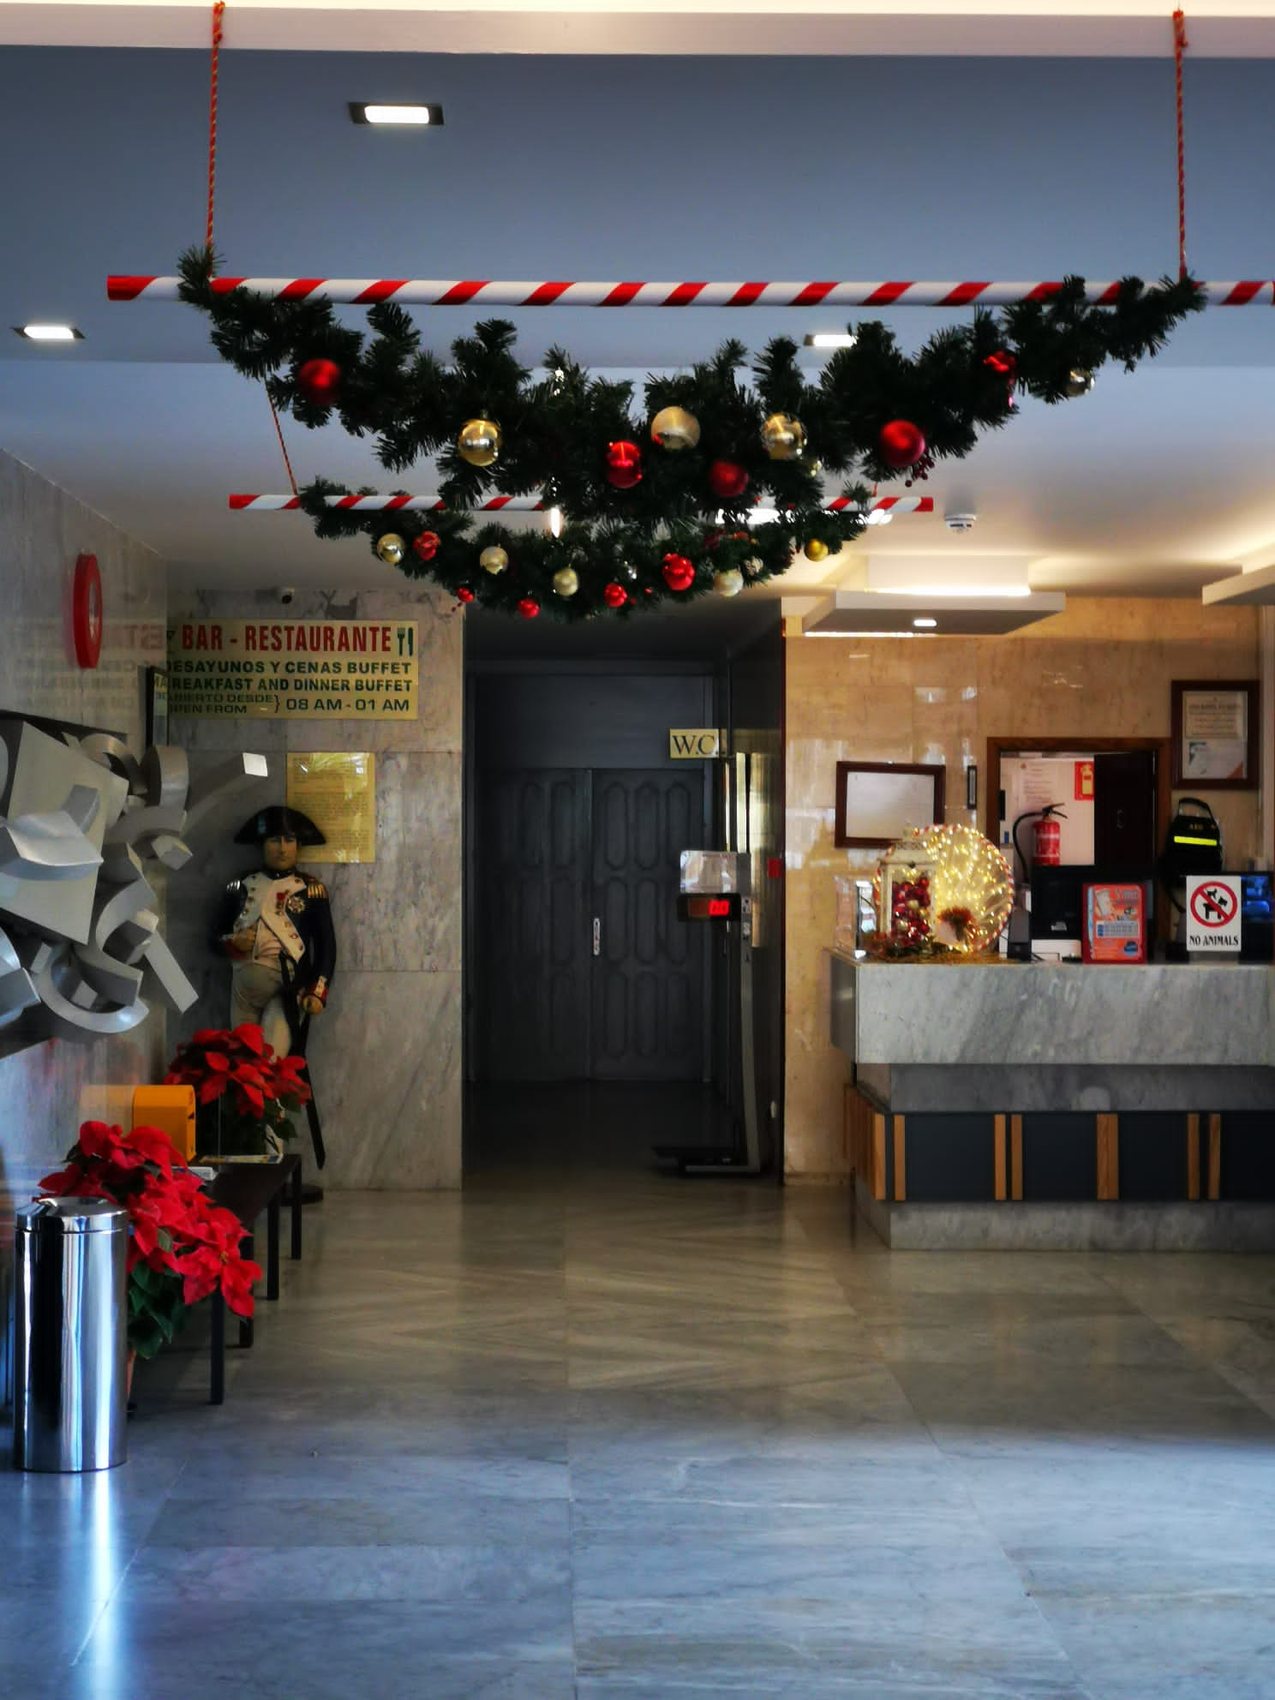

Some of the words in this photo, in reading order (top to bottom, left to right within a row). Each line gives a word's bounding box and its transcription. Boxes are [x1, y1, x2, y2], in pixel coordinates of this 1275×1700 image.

[182, 624, 222, 651] BAR
[245, 625, 392, 652] RESTAURANTE
[270, 661, 281, 673] Y
[285, 661, 342, 674] CENAS
[347, 662, 411, 674] BUFFET
[169, 678, 252, 691] REAKFAST
[257, 678, 289, 691] AND
[294, 679, 350, 691] DINNER
[354, 679, 413, 692] BUFFET
[206, 704, 247, 714] FROM
[286, 698, 309, 711] 08
[313, 699, 342, 711] AM
[355, 699, 376, 711] 01
[382, 699, 410, 711] AM
[1189, 935, 1201, 946] NO
[1203, 935, 1239, 946] ANIMALS
